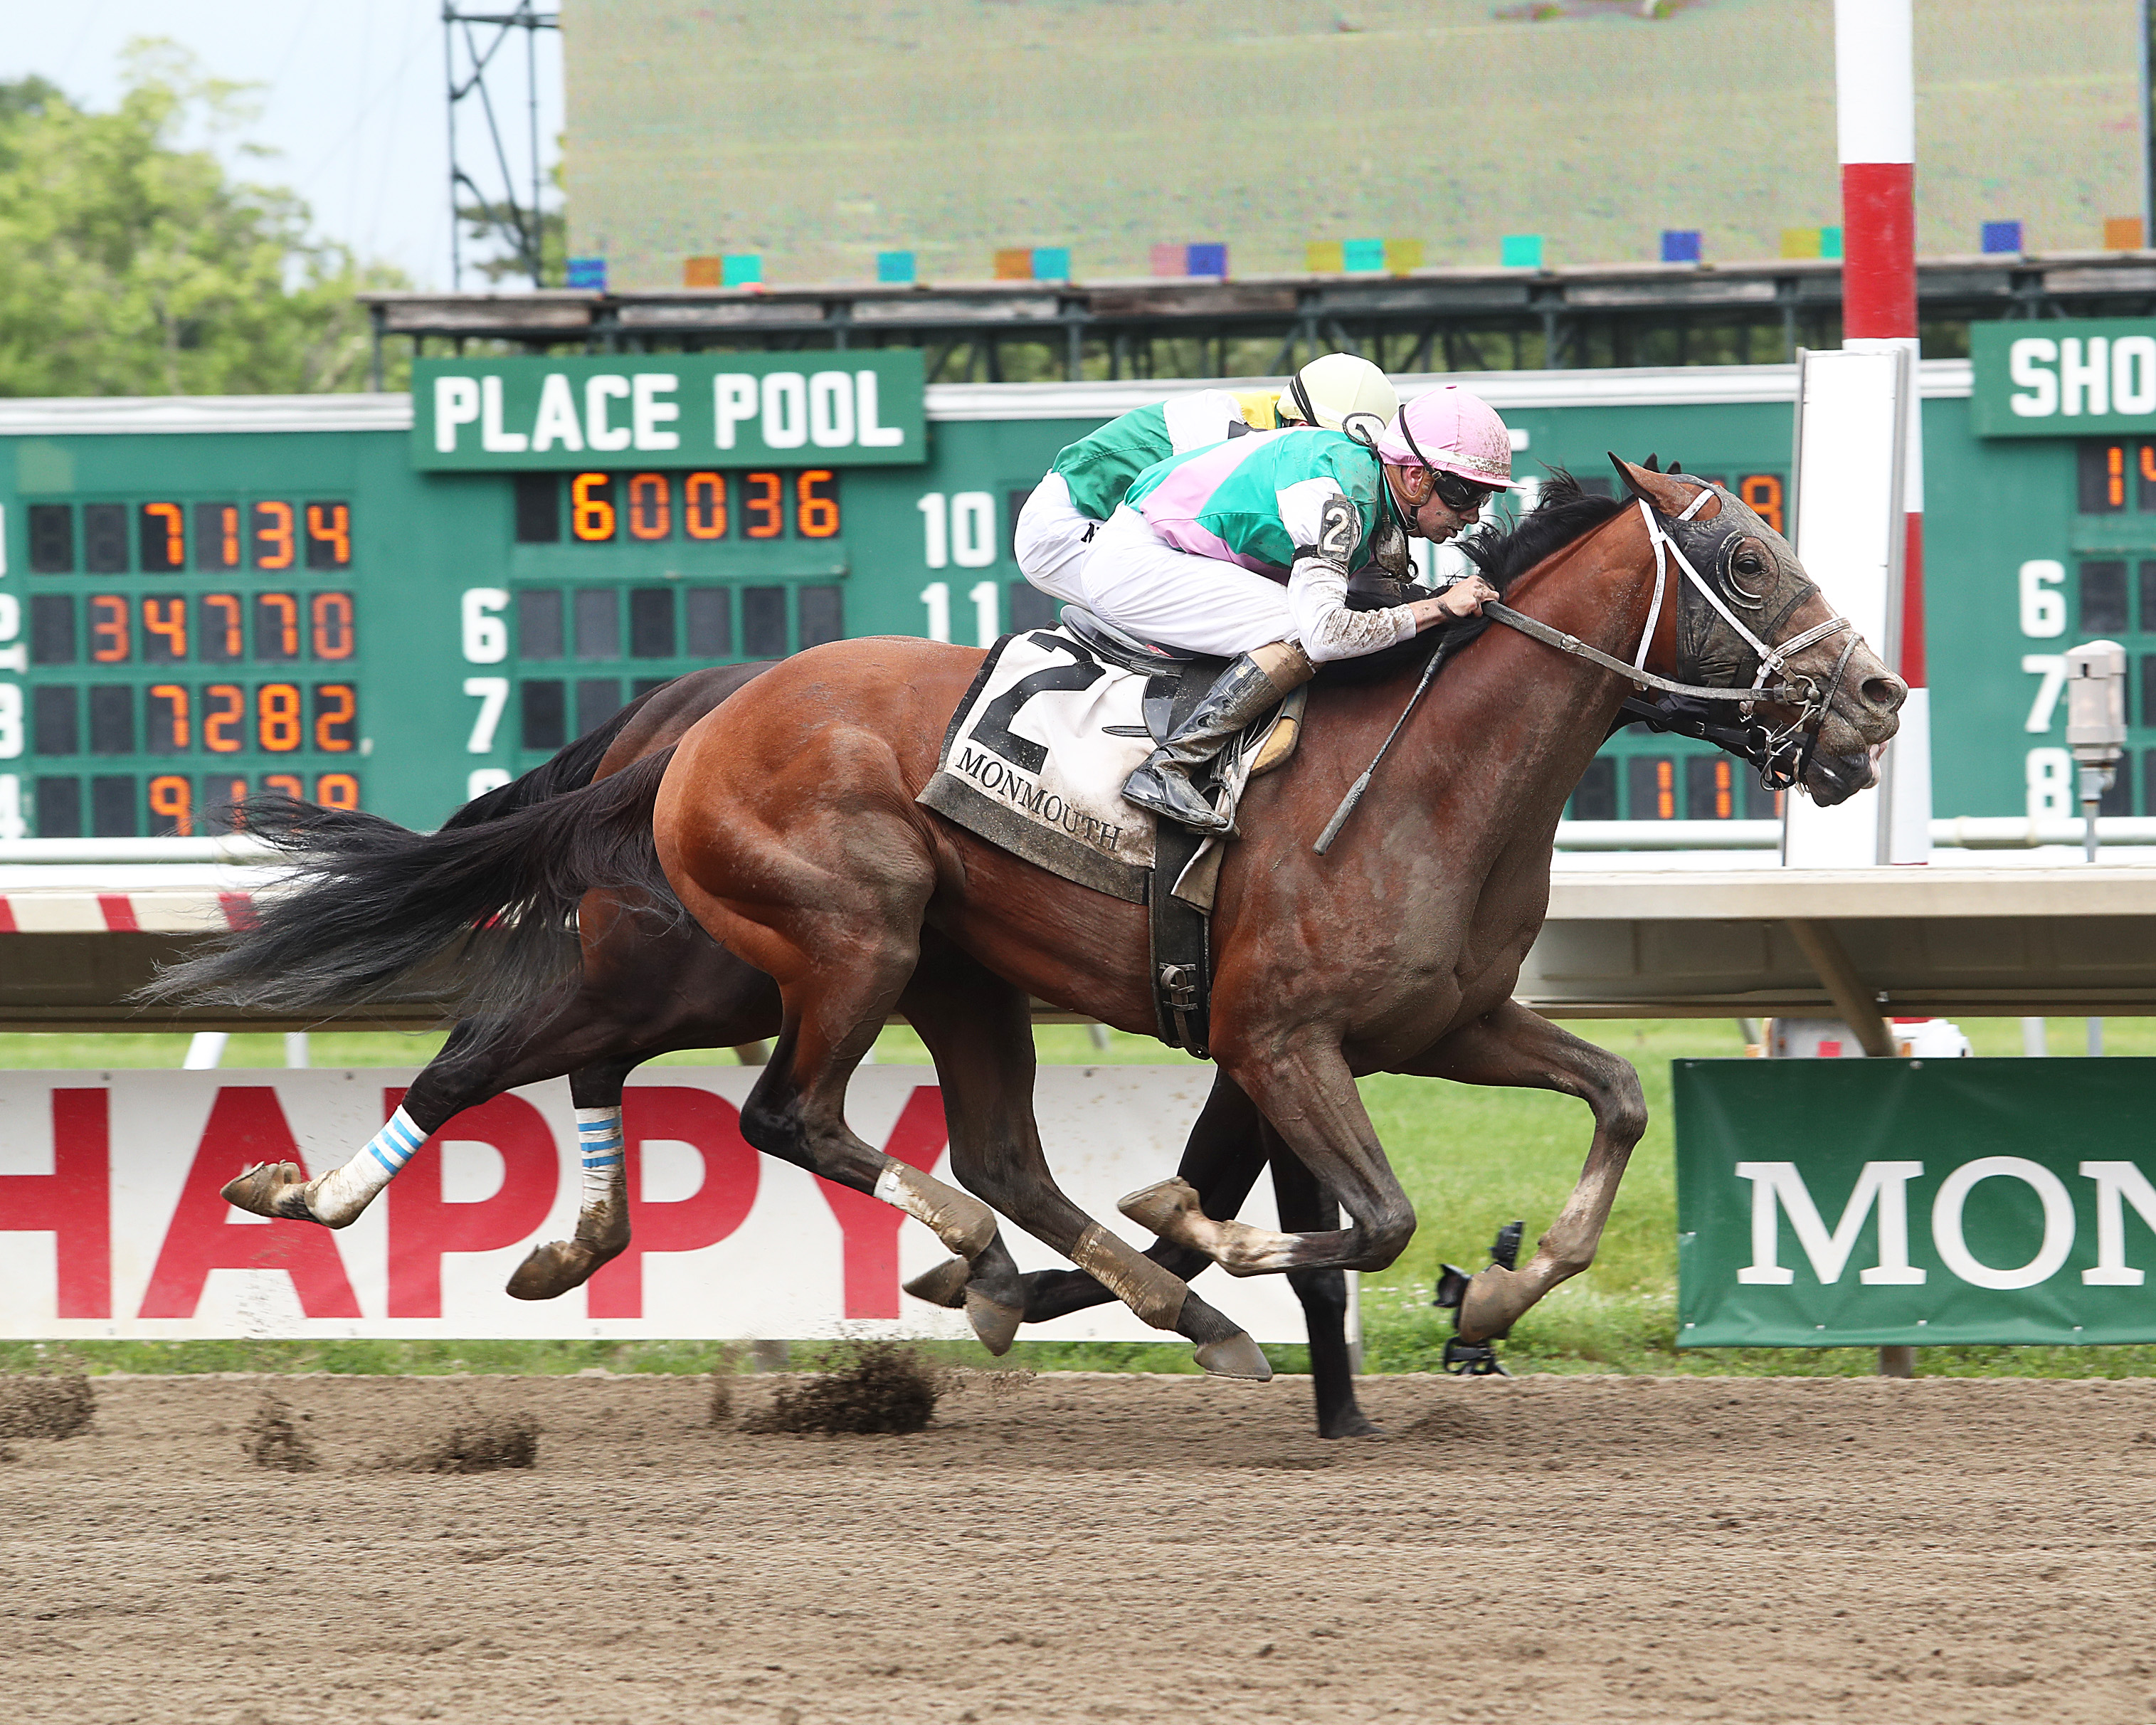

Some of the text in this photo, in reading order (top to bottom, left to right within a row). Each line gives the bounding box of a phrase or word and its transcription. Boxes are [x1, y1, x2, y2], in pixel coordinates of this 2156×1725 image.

[434, 369, 905, 453] PLACE POOL
[2009, 335, 2156, 418] SHO
[145, 500, 351, 569] 7134
[571, 470, 840, 542] 60036
[917, 491, 996, 569] 10
[1323, 506, 1351, 554] 2
[95, 593, 354, 663] 34770
[462, 587, 509, 665] 6
[919, 581, 998, 649] 11
[2019, 559, 2066, 639] 6
[151, 683, 356, 753] 7282
[463, 676, 509, 754] 7
[968, 631, 1106, 776] 2
[2021, 653, 2067, 733] 7
[955, 747, 1124, 853] MONMOUTH
[2024, 747, 2073, 817] 8
[0, 1086, 949, 1319] HAPPY
